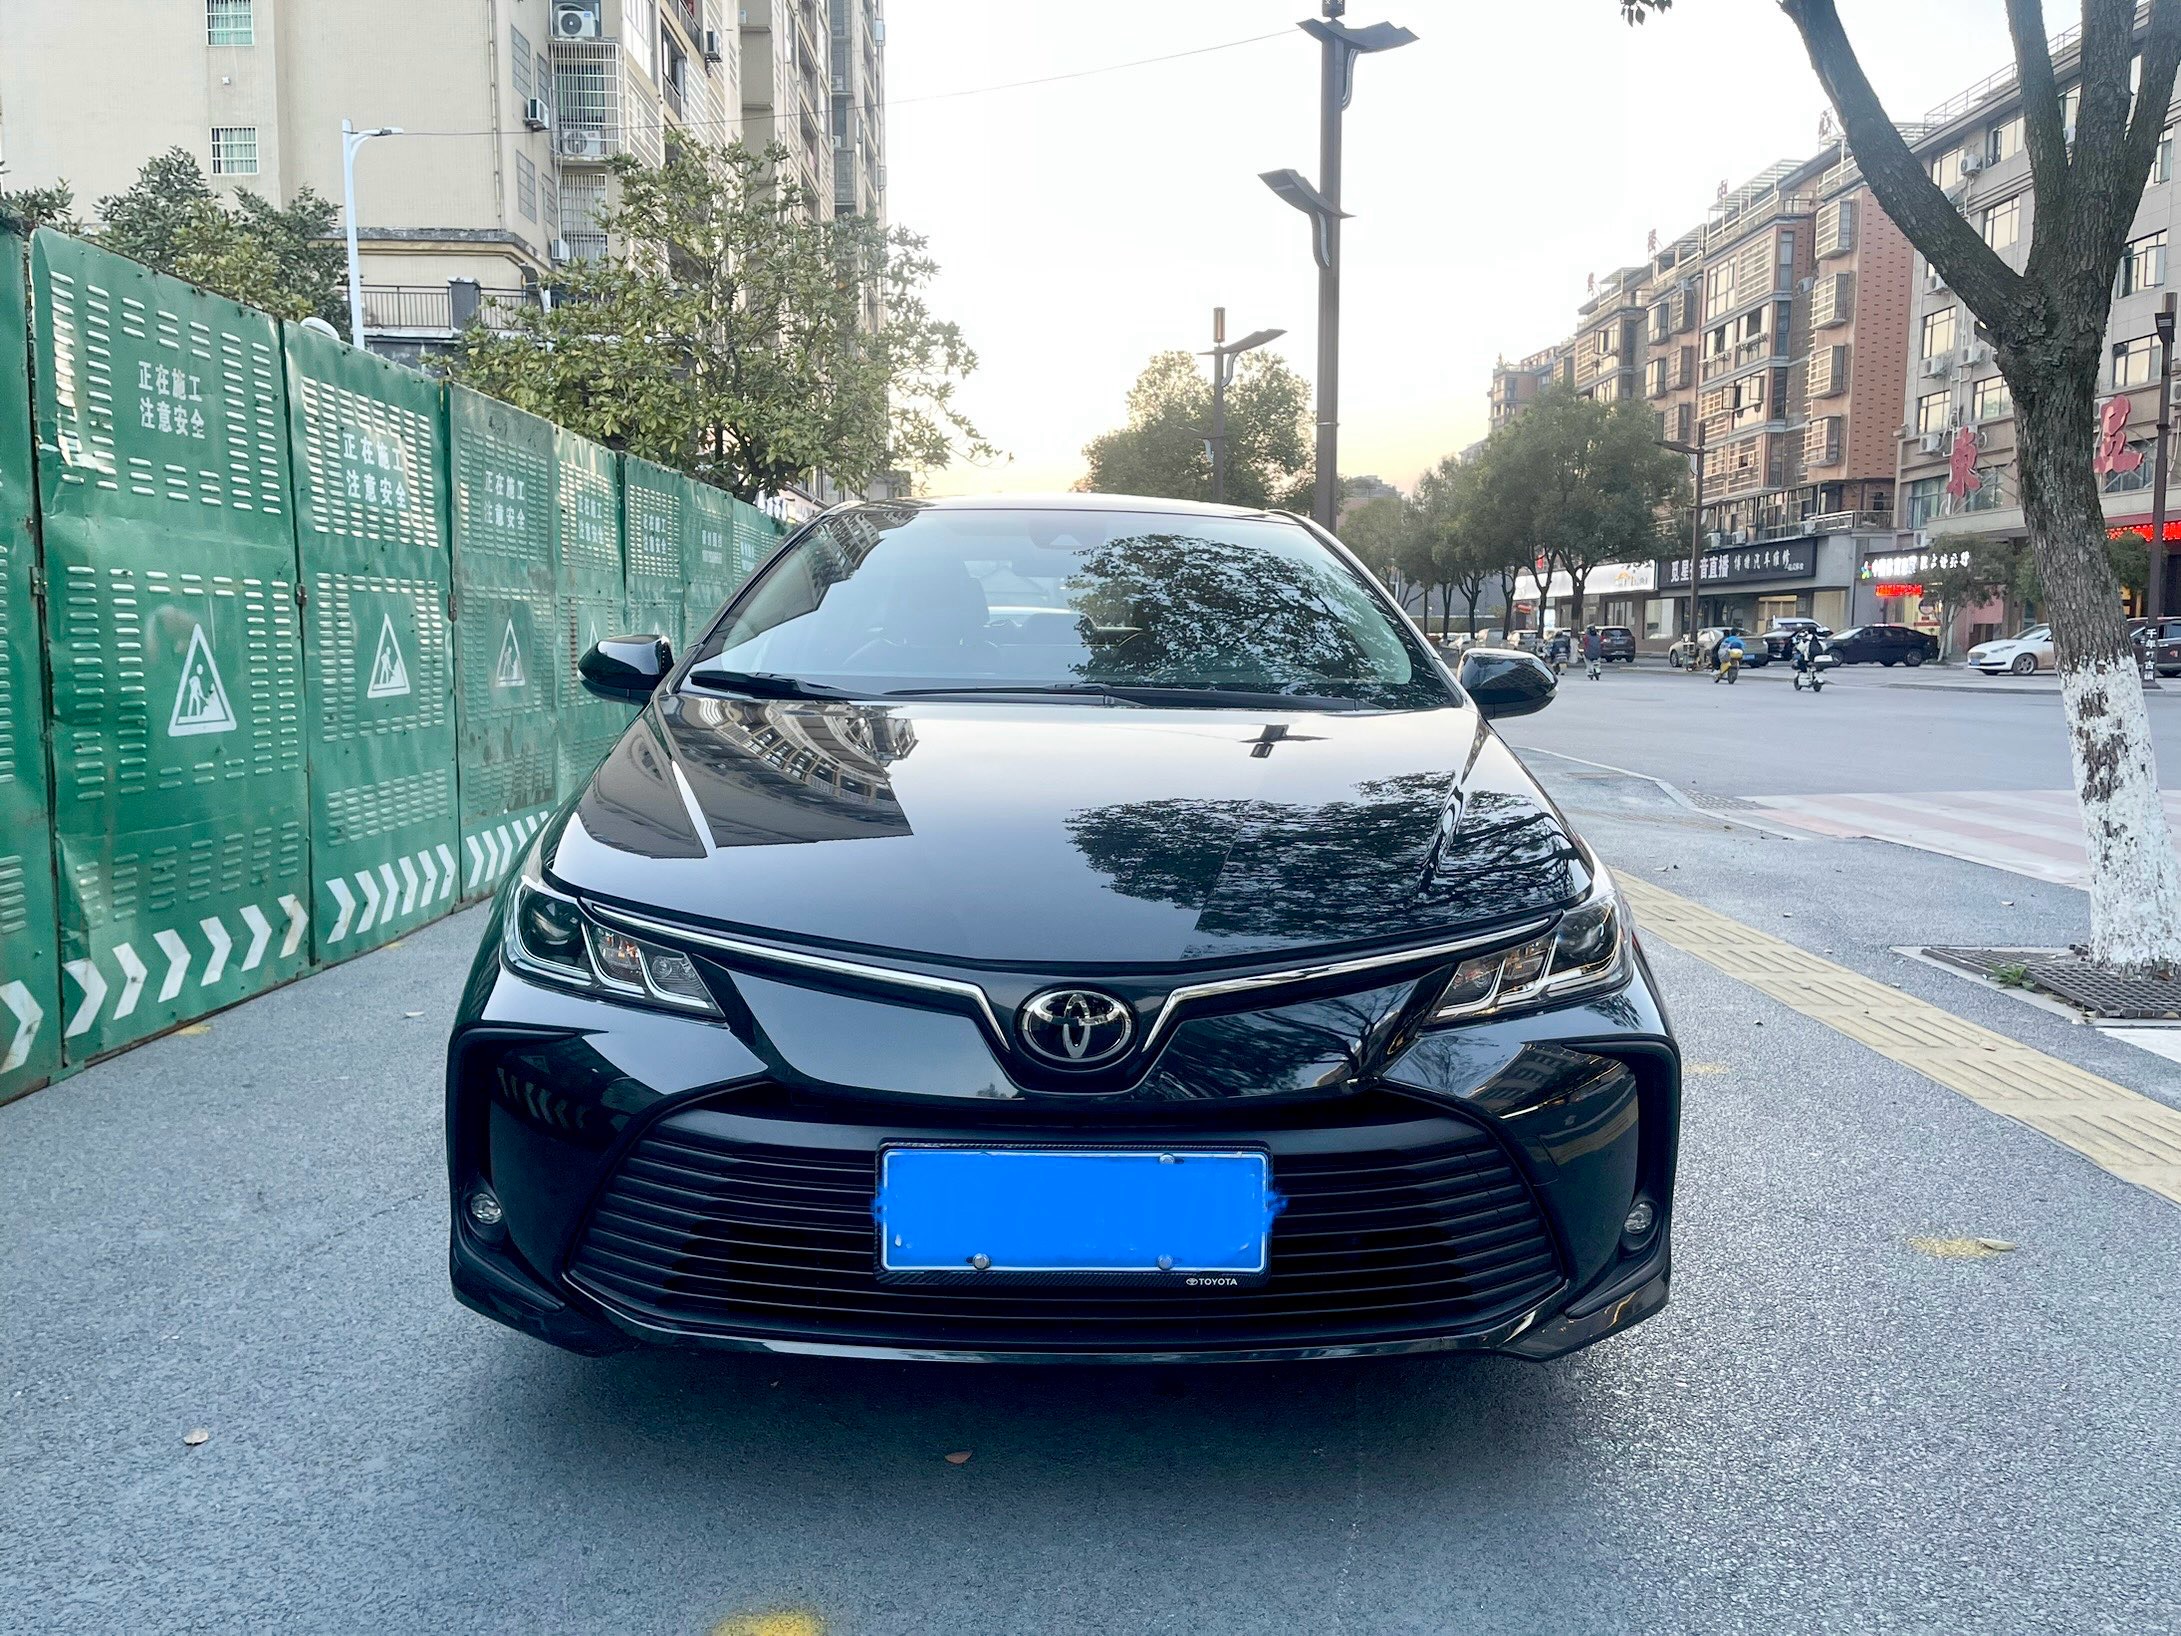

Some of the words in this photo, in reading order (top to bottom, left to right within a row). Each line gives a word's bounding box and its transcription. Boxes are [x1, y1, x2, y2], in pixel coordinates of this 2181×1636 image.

[138, 361, 202, 402] 正在施工
[139, 397, 205, 439] 注意安全
[343, 433, 403, 472] 正在施工
[346, 469, 406, 509] 注意安全
[484, 470, 525, 500] 正在施工
[484, 500, 525, 530] 注意安全
[1671, 554, 1729, 582] 觅星音直播
